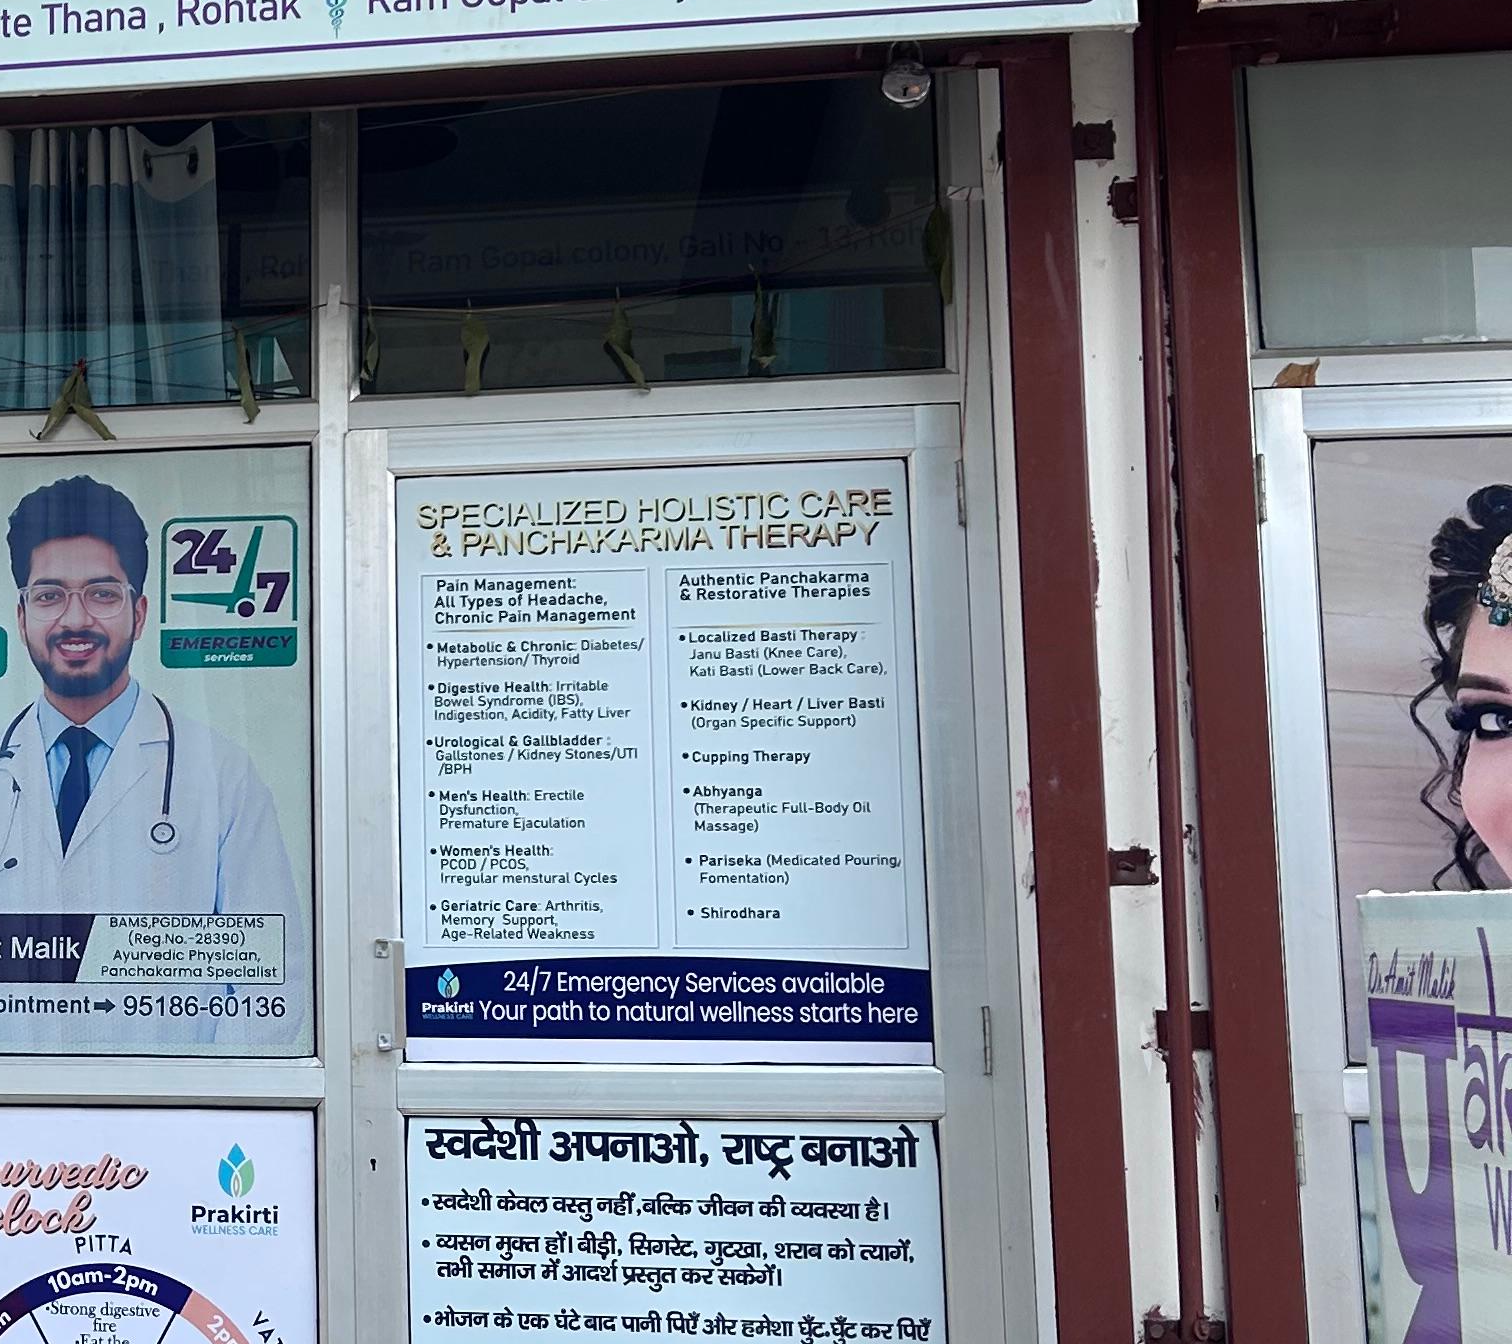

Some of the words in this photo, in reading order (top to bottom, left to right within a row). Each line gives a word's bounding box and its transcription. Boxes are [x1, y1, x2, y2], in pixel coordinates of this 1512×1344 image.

[41, 3, 145, 35] Thana
[420, 500, 626, 529] SPECIALIZED
[639, 495, 789, 523] HOLISTIC
[802, 489, 893, 517] CARE
[433, 533, 452, 557] &
[462, 523, 712, 556] PANCHAKARMA
[720, 521, 879, 549] THERAPY
[172, 529, 236, 574] 24
[437, 580, 468, 592] Pain
[475, 578, 576, 593] Management:
[679, 574, 754, 586] Authentic
[761, 571, 869, 585] Panchakarma
[435, 596, 455, 608] All
[459, 595, 502, 610] Types
[509, 595, 522, 606] of
[528, 593, 607, 606] Headache,
[680, 589, 691, 600] &
[697, 587, 786, 600] Restorative
[791, 586, 870, 600] Therapies
[435, 612, 493, 624] Chronic
[499, 611, 530, 623] Pain
[537, 608, 635, 623] Management
[169, 636, 292, 649] EMERGENCY
[204, 652, 253, 662] services
[693, 751, 748, 765] Cupping
[753, 751, 810, 764] Therapy
[693, 786, 762, 799] Abhyanga
[701, 907, 780, 918] Shirodhara
[12, 937, 80, 959] Malik
[113, 949, 184, 963] Ayurvedic
[189, 949, 260, 963] Physician,
[102, 965, 202, 977] Panchakarma
[207, 965, 277, 979] Specialist
[504, 967, 551, 995] 24/7
[558, 972, 680, 999] Emergency
[686, 971, 776, 993] Services
[782, 972, 884, 993] available
[124, 996, 285, 1017] 95186-60136
[422, 1002, 474, 1014] Prakirti
[479, 1001, 527, 1020] Your
[533, 1000, 583, 1027] path
[588, 1002, 610, 1021] to
[617, 1001, 694, 1021] natural
[700, 1001, 793, 1022] wellness
[800, 1003, 862, 1023] starts
[868, 1002, 918, 1023] here
[425, 1118, 541, 1160] स्वदेशी
[549, 1120, 709, 1167] अपनाओ,
[721, 1134, 795, 1180] राष्ट्र
[800, 1124, 919, 1168] बनाओ
[192, 1205, 278, 1224] Prakirti
[432, 1188, 492, 1211] स्वदेशी
[496, 1189, 548, 1213] केवल
[552, 1197, 593, 1222] वस्तु
[697, 1193, 754, 1217] जीवन
[758, 1195, 786, 1217] की
[790, 1202, 860, 1219] व्यवस्था
[191, 1224, 246, 1236] WELLNESS
[249, 1224, 279, 1237] CARE
[75, 1235, 132, 1255] PITTA
[436, 1234, 491, 1251] व्यसन
[496, 1236, 540, 1260] मुक्त
[48, 1266, 158, 1296] 10am-2pm
[50, 1302, 97, 1317] Strong
[100, 1303, 160, 1318] digestive
